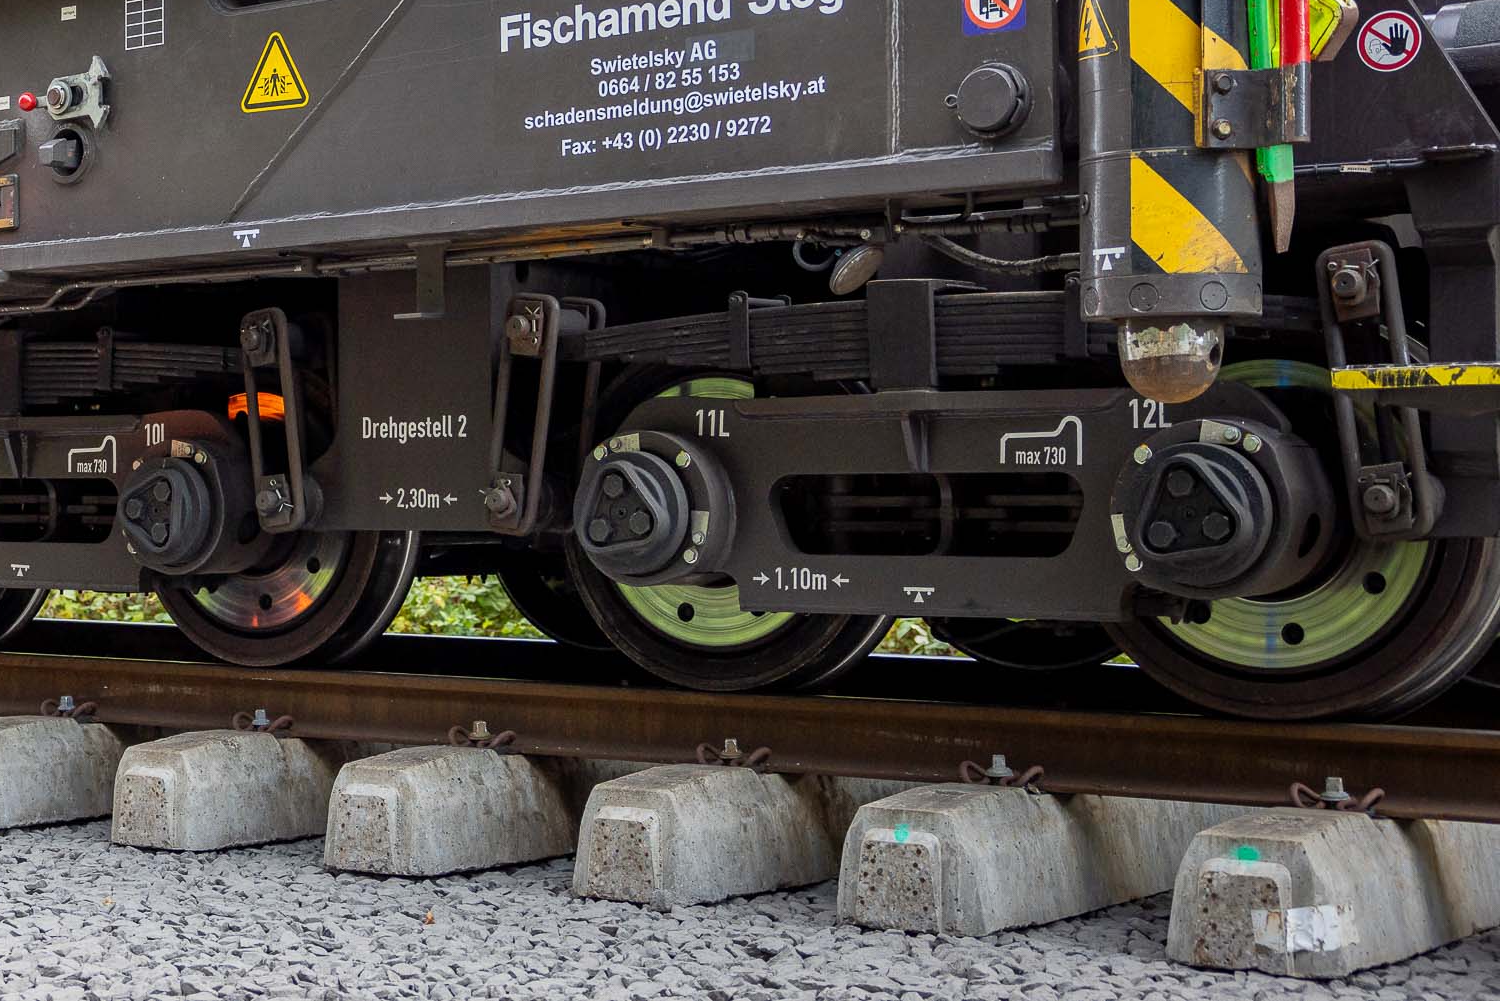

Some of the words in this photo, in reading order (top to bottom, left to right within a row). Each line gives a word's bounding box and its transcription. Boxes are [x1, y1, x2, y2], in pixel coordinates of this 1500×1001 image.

[590, 48, 685, 76] Swietelsky
[690, 39, 717, 63] AG
[599, 75, 640, 98] 0664
[643, 73, 650, 92] /
[655, 71, 676, 90] 82
[681, 67, 702, 87] 55
[708, 62, 740, 84] 153
[524, 75, 826, 130] schadensmeldung@swietelsky.at
[561, 138, 597, 157] Fax:
[602, 132, 633, 150] +43
[638, 127, 662, 152] (0)
[667, 122, 710, 145] 2230
[714, 120, 722, 139] /
[726, 115, 772, 138] 9272
[695, 409, 730, 437] 11L
[1128, 398, 1173, 429] 12L
[362, 415, 453, 444] Drehgestell
[457, 414, 467, 438] 2
[76, 462, 92, 473] max
[93, 459, 107, 473] 730
[1015, 450, 1041, 465] max
[1044, 446, 1066, 465] 730
[396, 488, 440, 510] 2,30m
[774, 567, 827, 591] 1,10m
